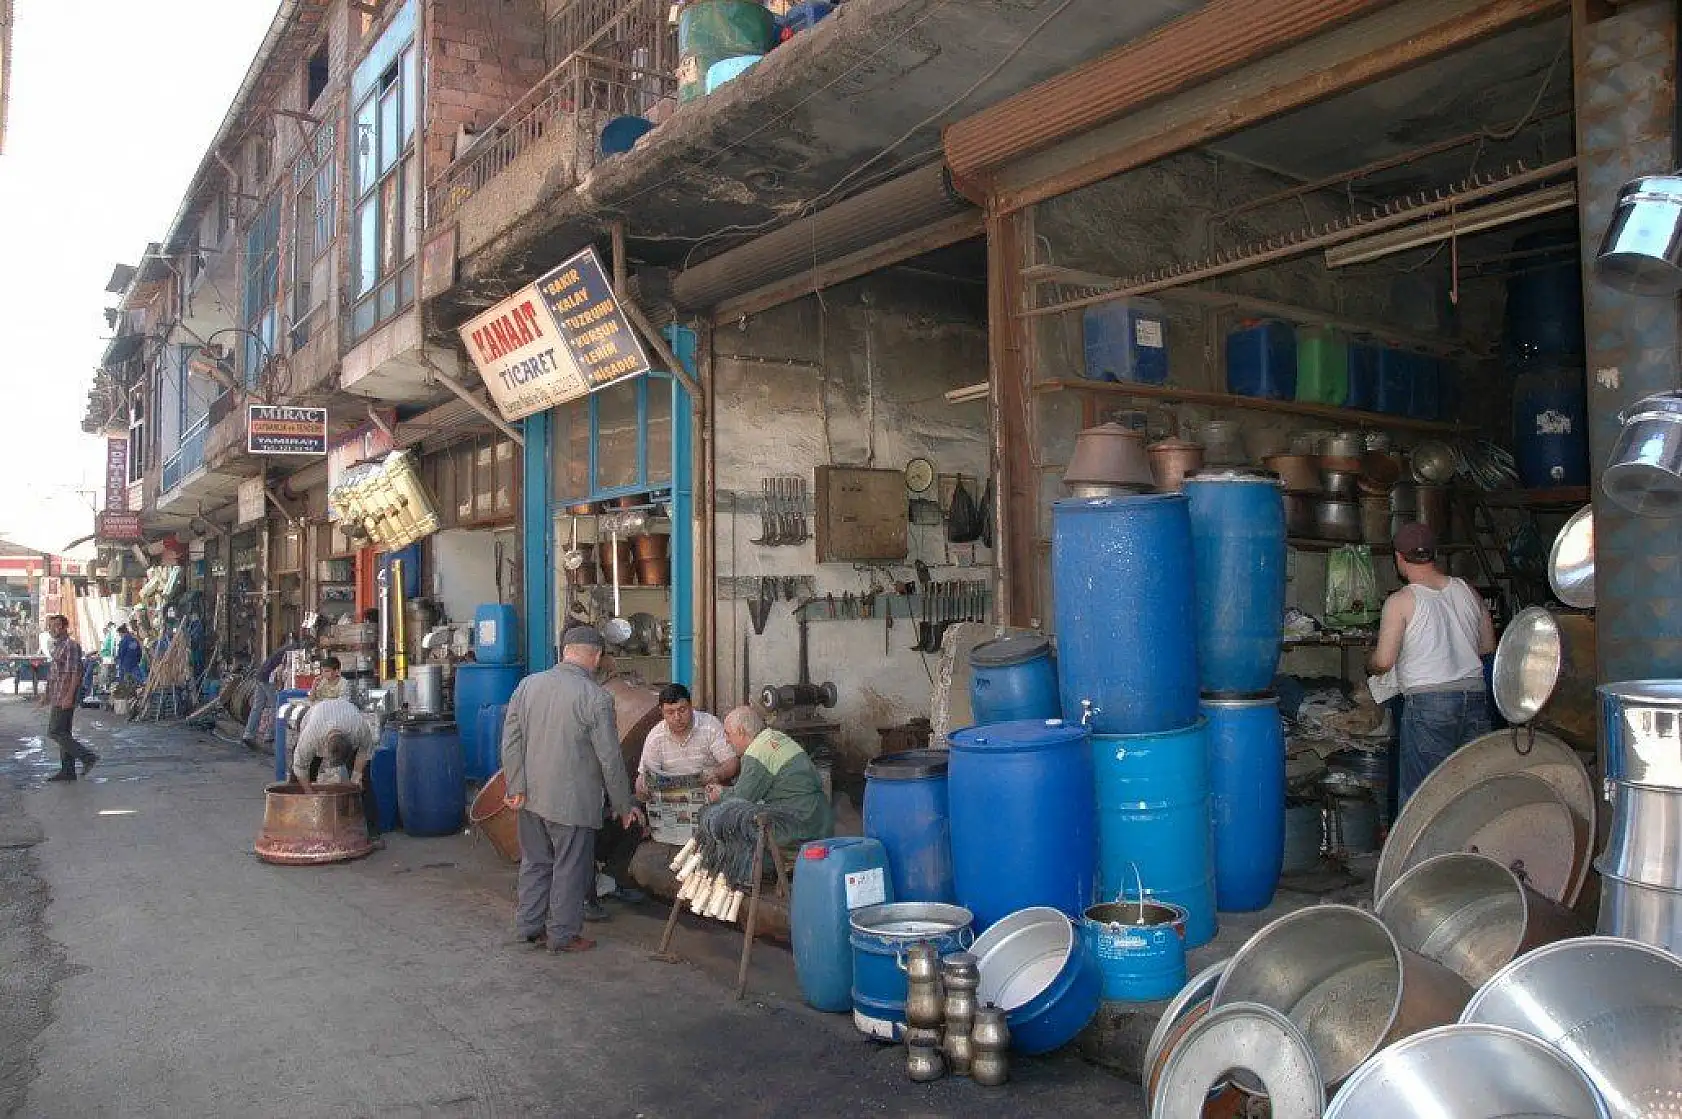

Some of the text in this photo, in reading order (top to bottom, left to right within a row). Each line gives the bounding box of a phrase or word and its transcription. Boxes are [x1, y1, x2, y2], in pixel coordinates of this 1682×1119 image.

[556, 287, 588, 313] KALAY
[472, 300, 543, 365] KANAAT
[499, 348, 557, 390] TİCARET
